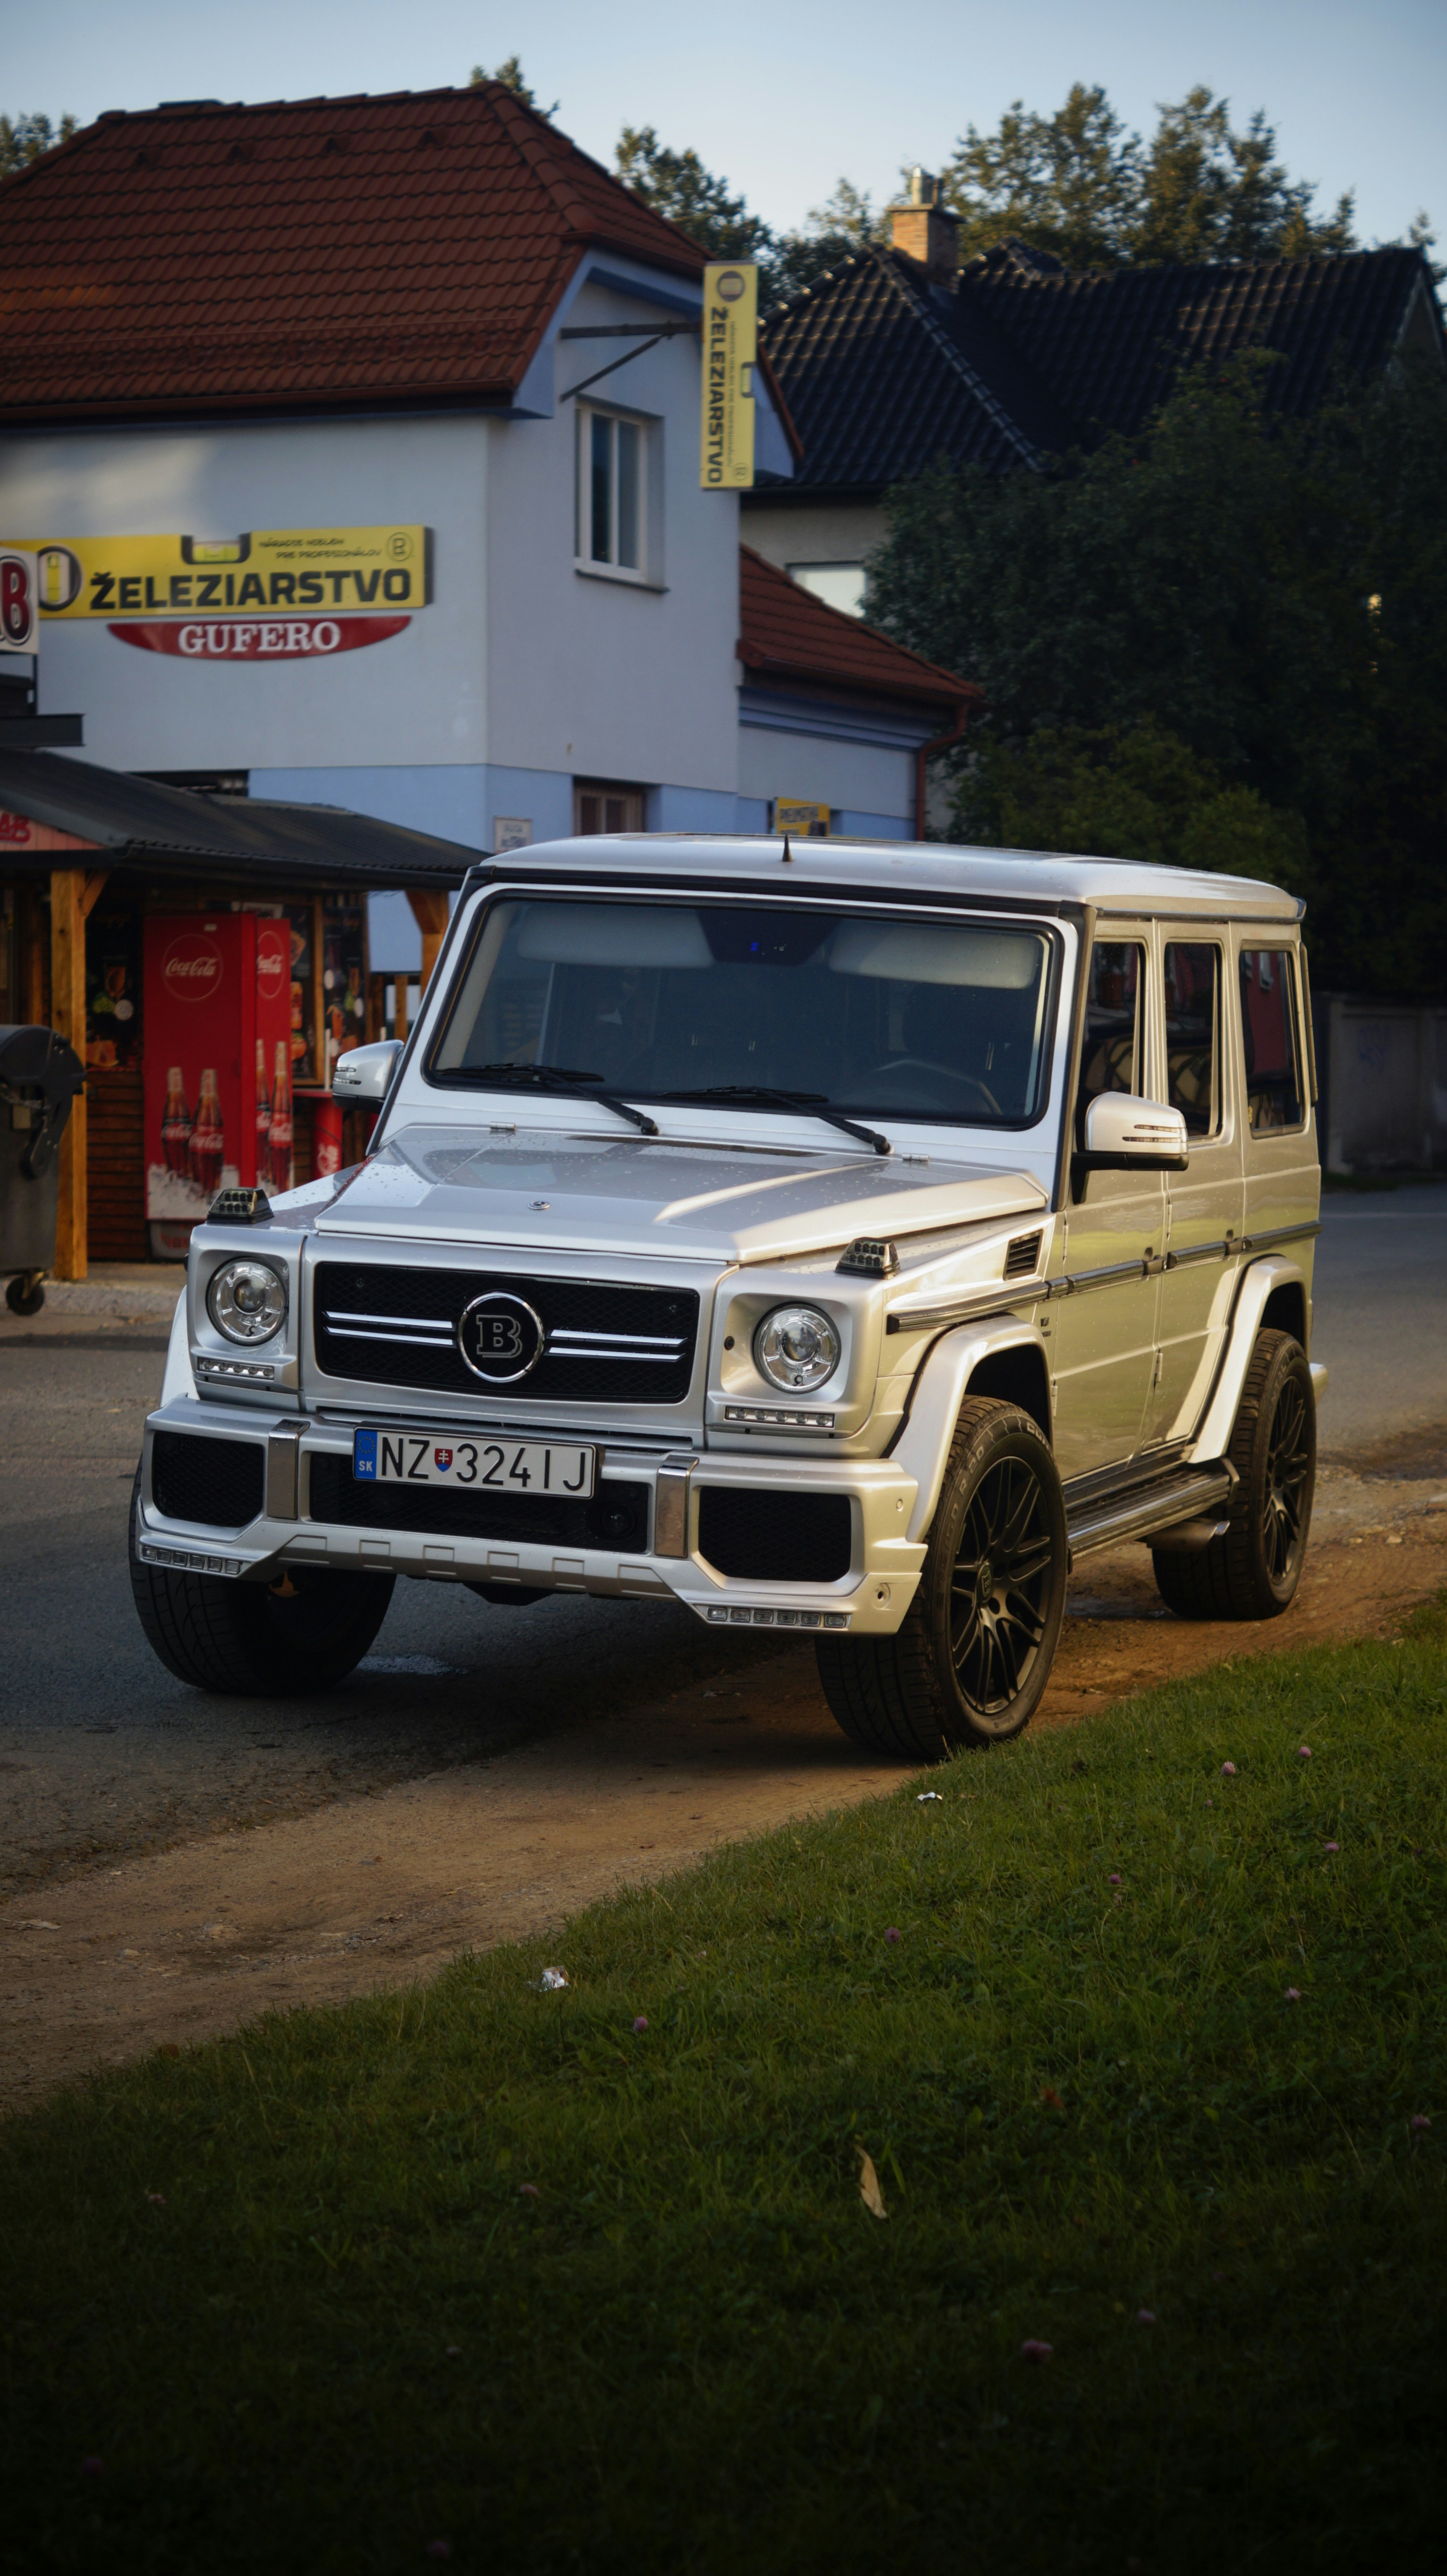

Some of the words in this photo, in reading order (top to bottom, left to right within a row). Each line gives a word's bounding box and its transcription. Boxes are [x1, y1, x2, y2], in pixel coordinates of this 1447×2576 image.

[708, 306, 729, 483] ŽELEZIARSTVO
[0, 559, 31, 642] B
[90, 568, 411, 610] ŽELEZIARSTVO
[178, 621, 341, 654] GUFERO
[476, 1314, 523, 1359] B
[358, 1460, 373, 1473] SK
[381, 1436, 430, 1480] NZ
